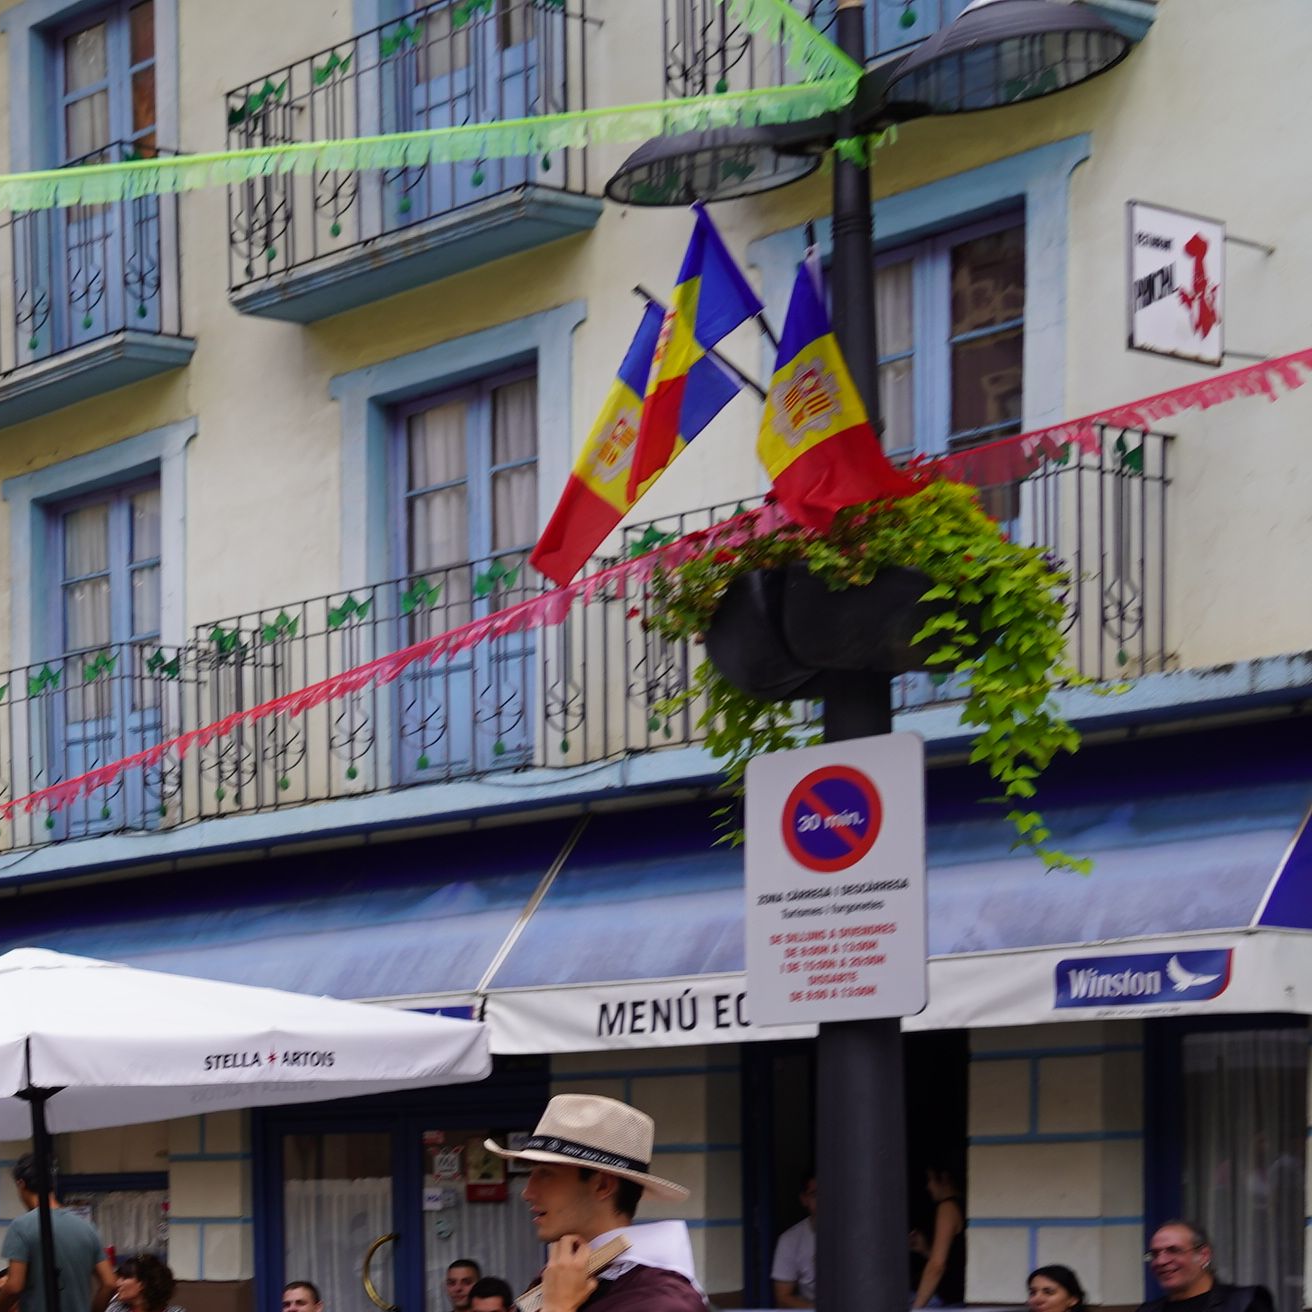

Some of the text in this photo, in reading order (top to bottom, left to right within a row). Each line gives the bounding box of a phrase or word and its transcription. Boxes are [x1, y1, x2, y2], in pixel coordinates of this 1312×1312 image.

[757, 893, 783, 905] ZONA
[781, 906, 824, 919] Turismes
[831, 900, 885, 915] furgonetes
[769, 932, 783, 945] DE
[785, 929, 827, 943] DILLUNS
[838, 922, 897, 939] DIVENDRES
[784, 947, 797, 959] DE
[786, 961, 800, 973] DE
[807, 971, 859, 986] DISSABTE
[1068, 968, 1161, 999] Winston
[789, 991, 803, 1003] DE
[598, 988, 752, 1037] MENÚ EC
[204, 1050, 336, 1071] STELLA ARTOIS
